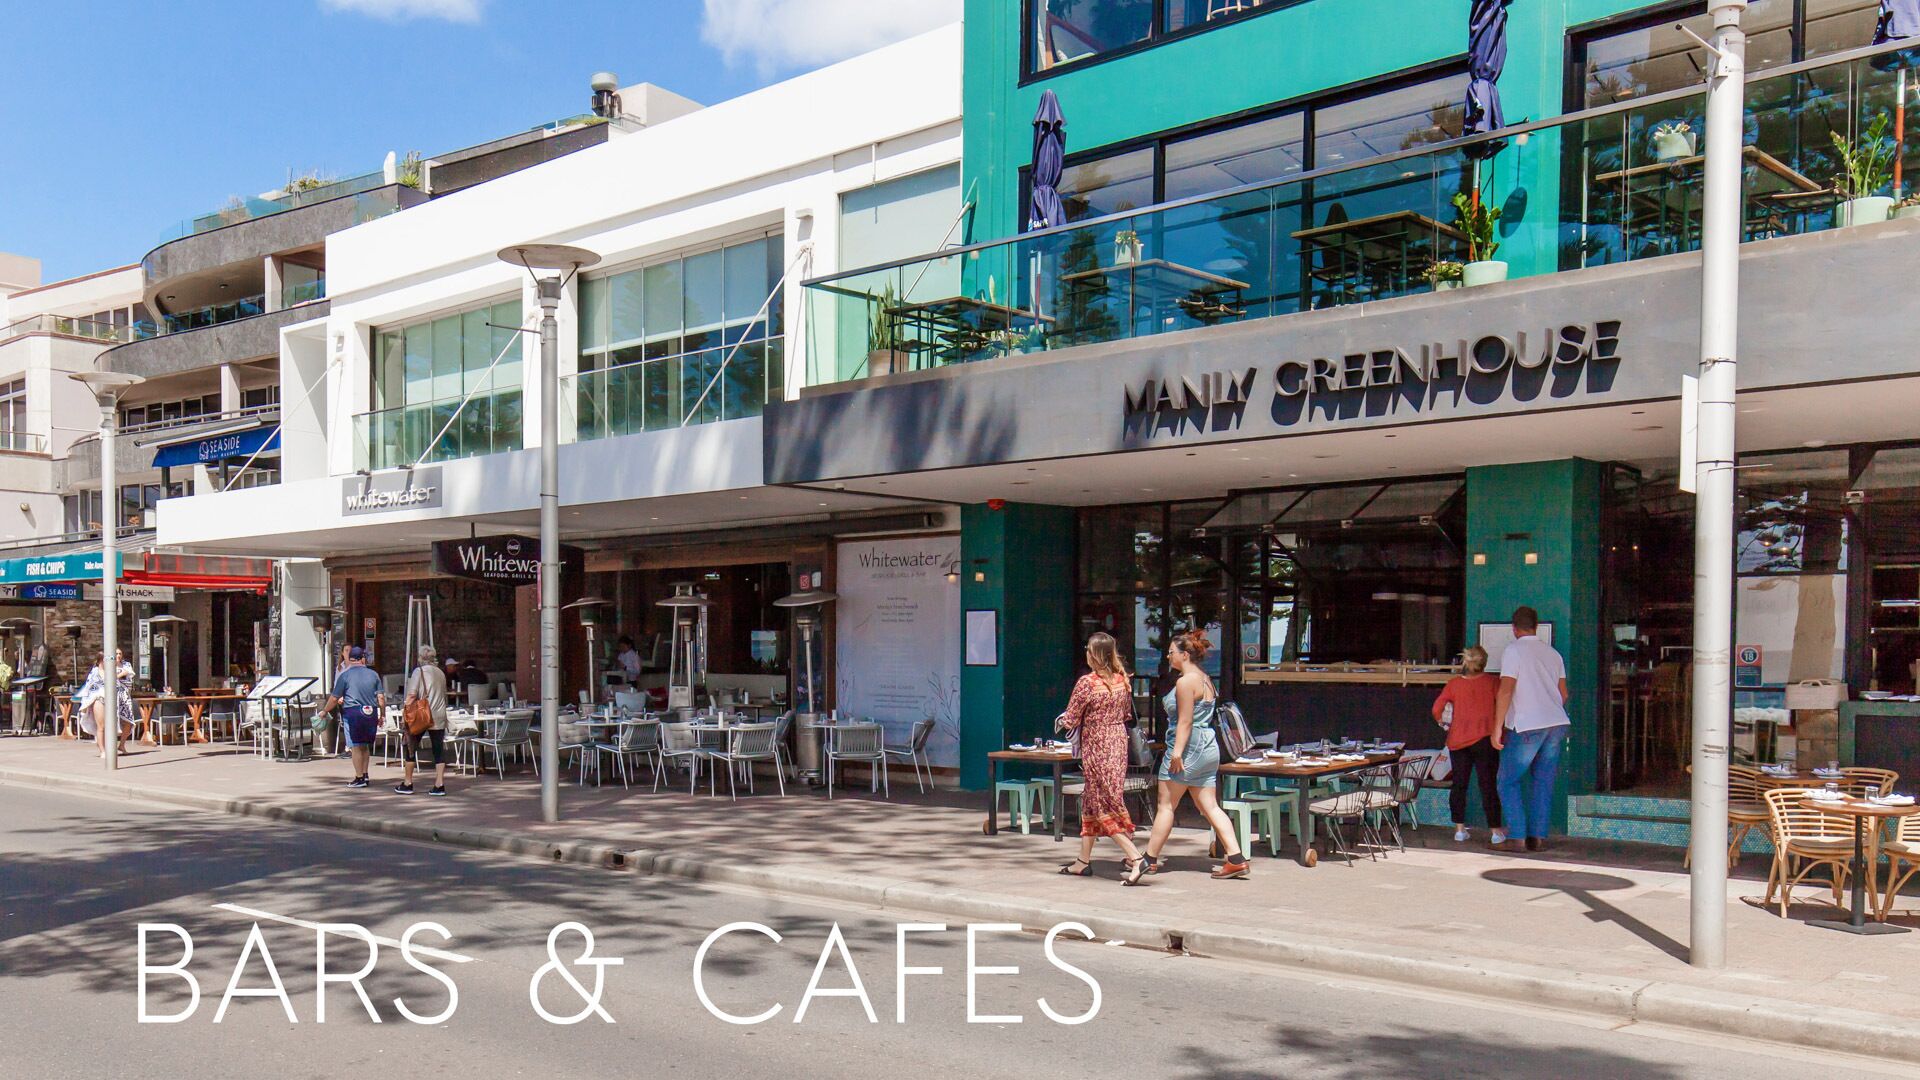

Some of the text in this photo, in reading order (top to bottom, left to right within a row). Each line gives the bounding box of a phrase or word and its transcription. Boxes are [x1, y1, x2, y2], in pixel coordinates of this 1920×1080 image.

[1122, 319, 1622, 415] MANLY GREENHOUSE
[209, 436, 240, 453] SEASIDE
[346, 482, 436, 509] whitewater
[458, 545, 566, 573] Whitewar
[859, 547, 941, 568] Whitewater
[26, 563, 40, 575] FISH
[40, 562, 46, 575] &
[46, 561, 65, 574] CHIPS
[49, 588, 77, 596] SEASIDE
[126, 588, 154, 597] SHACK
[1744, 653, 1754, 661] 18
